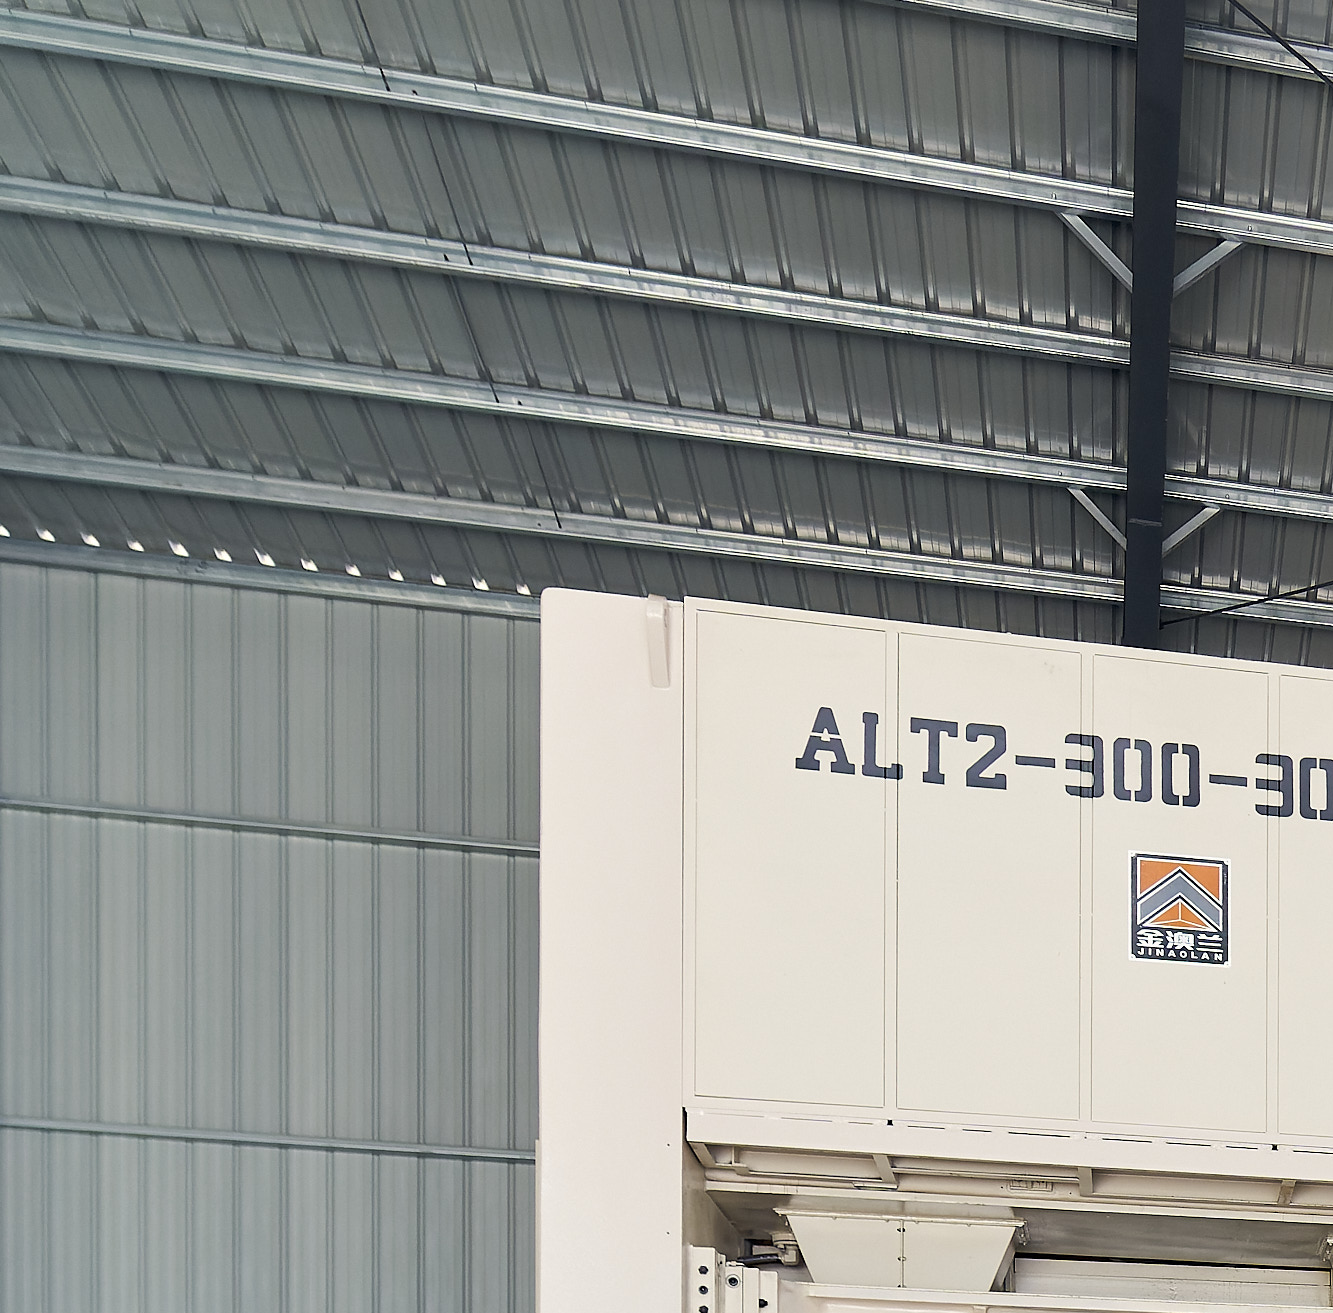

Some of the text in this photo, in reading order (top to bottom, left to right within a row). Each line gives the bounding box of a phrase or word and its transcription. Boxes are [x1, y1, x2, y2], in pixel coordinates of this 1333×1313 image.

[1136, 929, 1224, 953] 金澳兰
[1137, 947, 1223, 961] JINAOLAN
